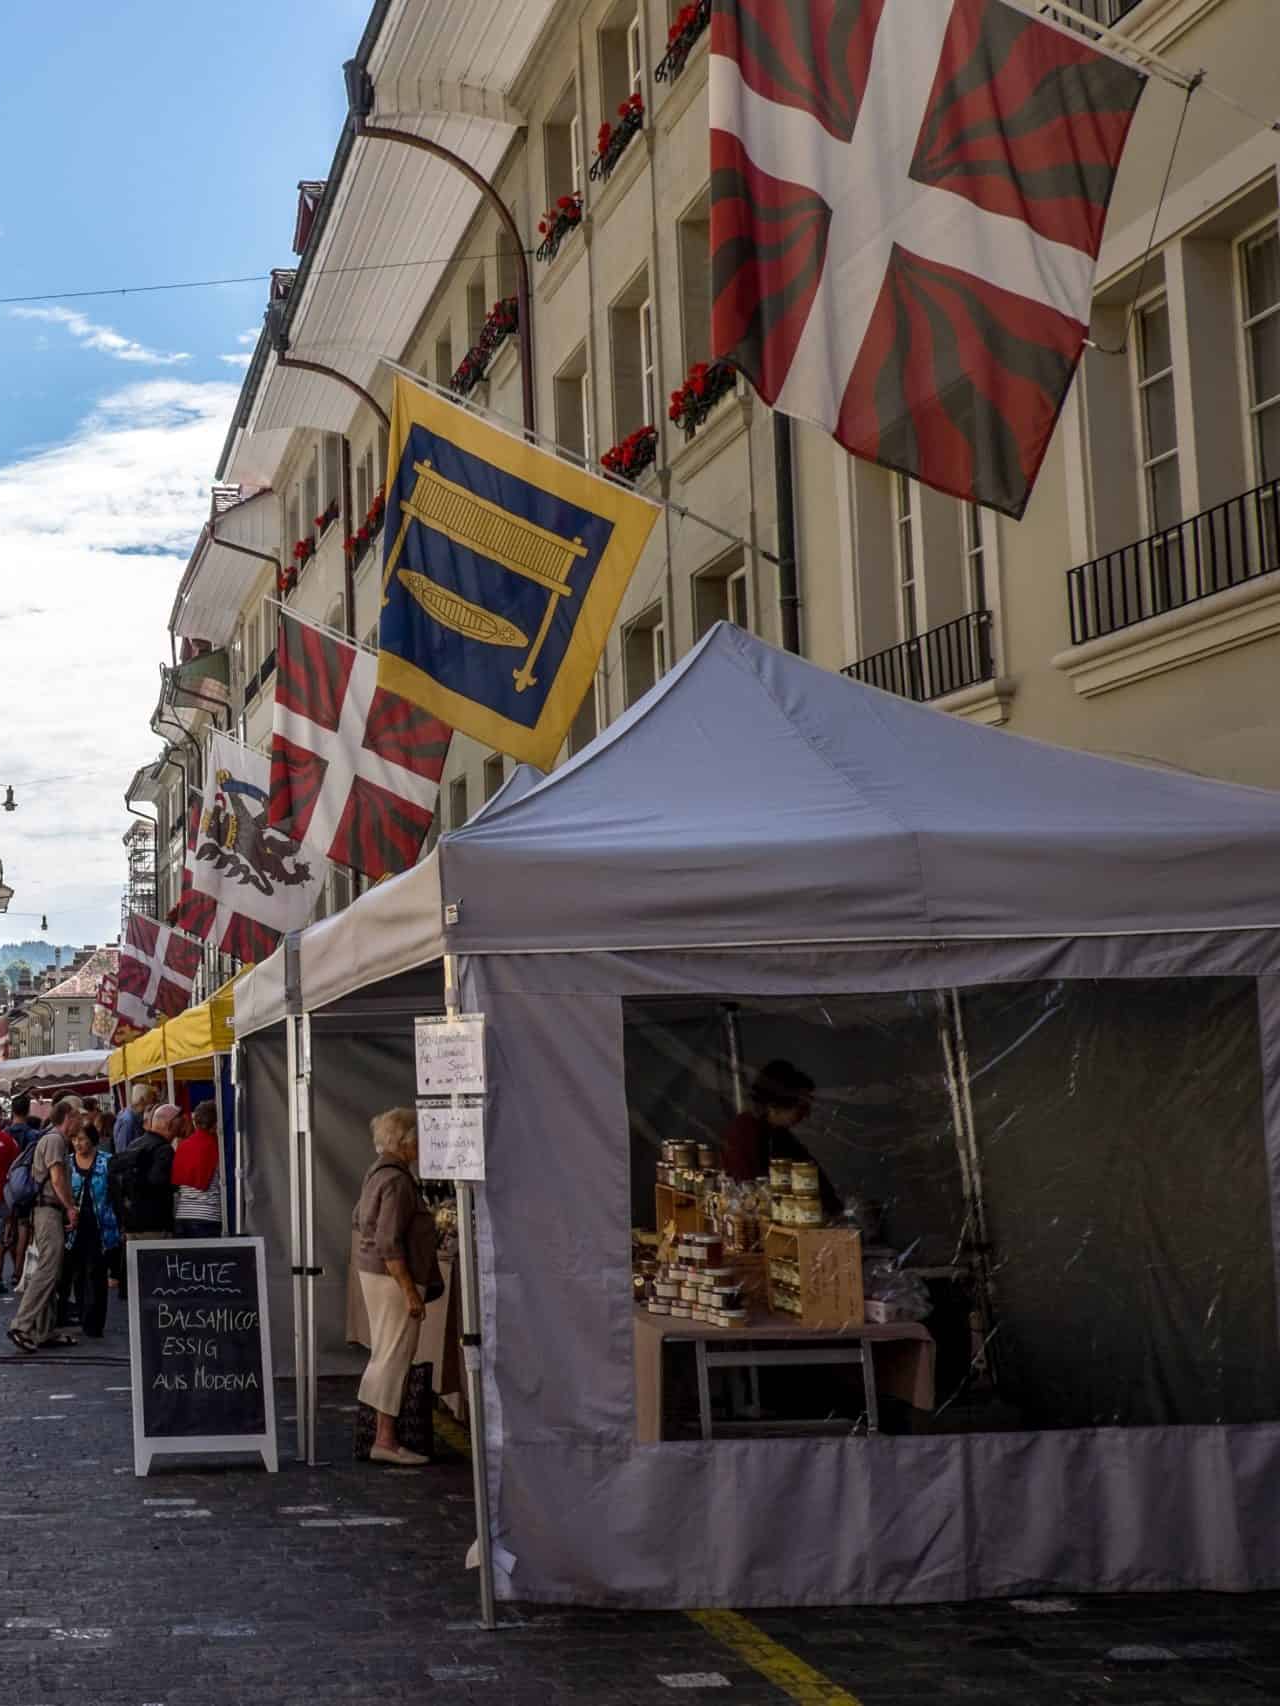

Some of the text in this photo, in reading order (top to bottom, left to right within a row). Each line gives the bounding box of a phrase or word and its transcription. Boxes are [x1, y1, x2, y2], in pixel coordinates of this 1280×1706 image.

[166, 1255, 238, 1284] HEUTE
[162, 1336, 218, 1359] ESSIG
[152, 1365, 259, 1391] AUS MODENA
